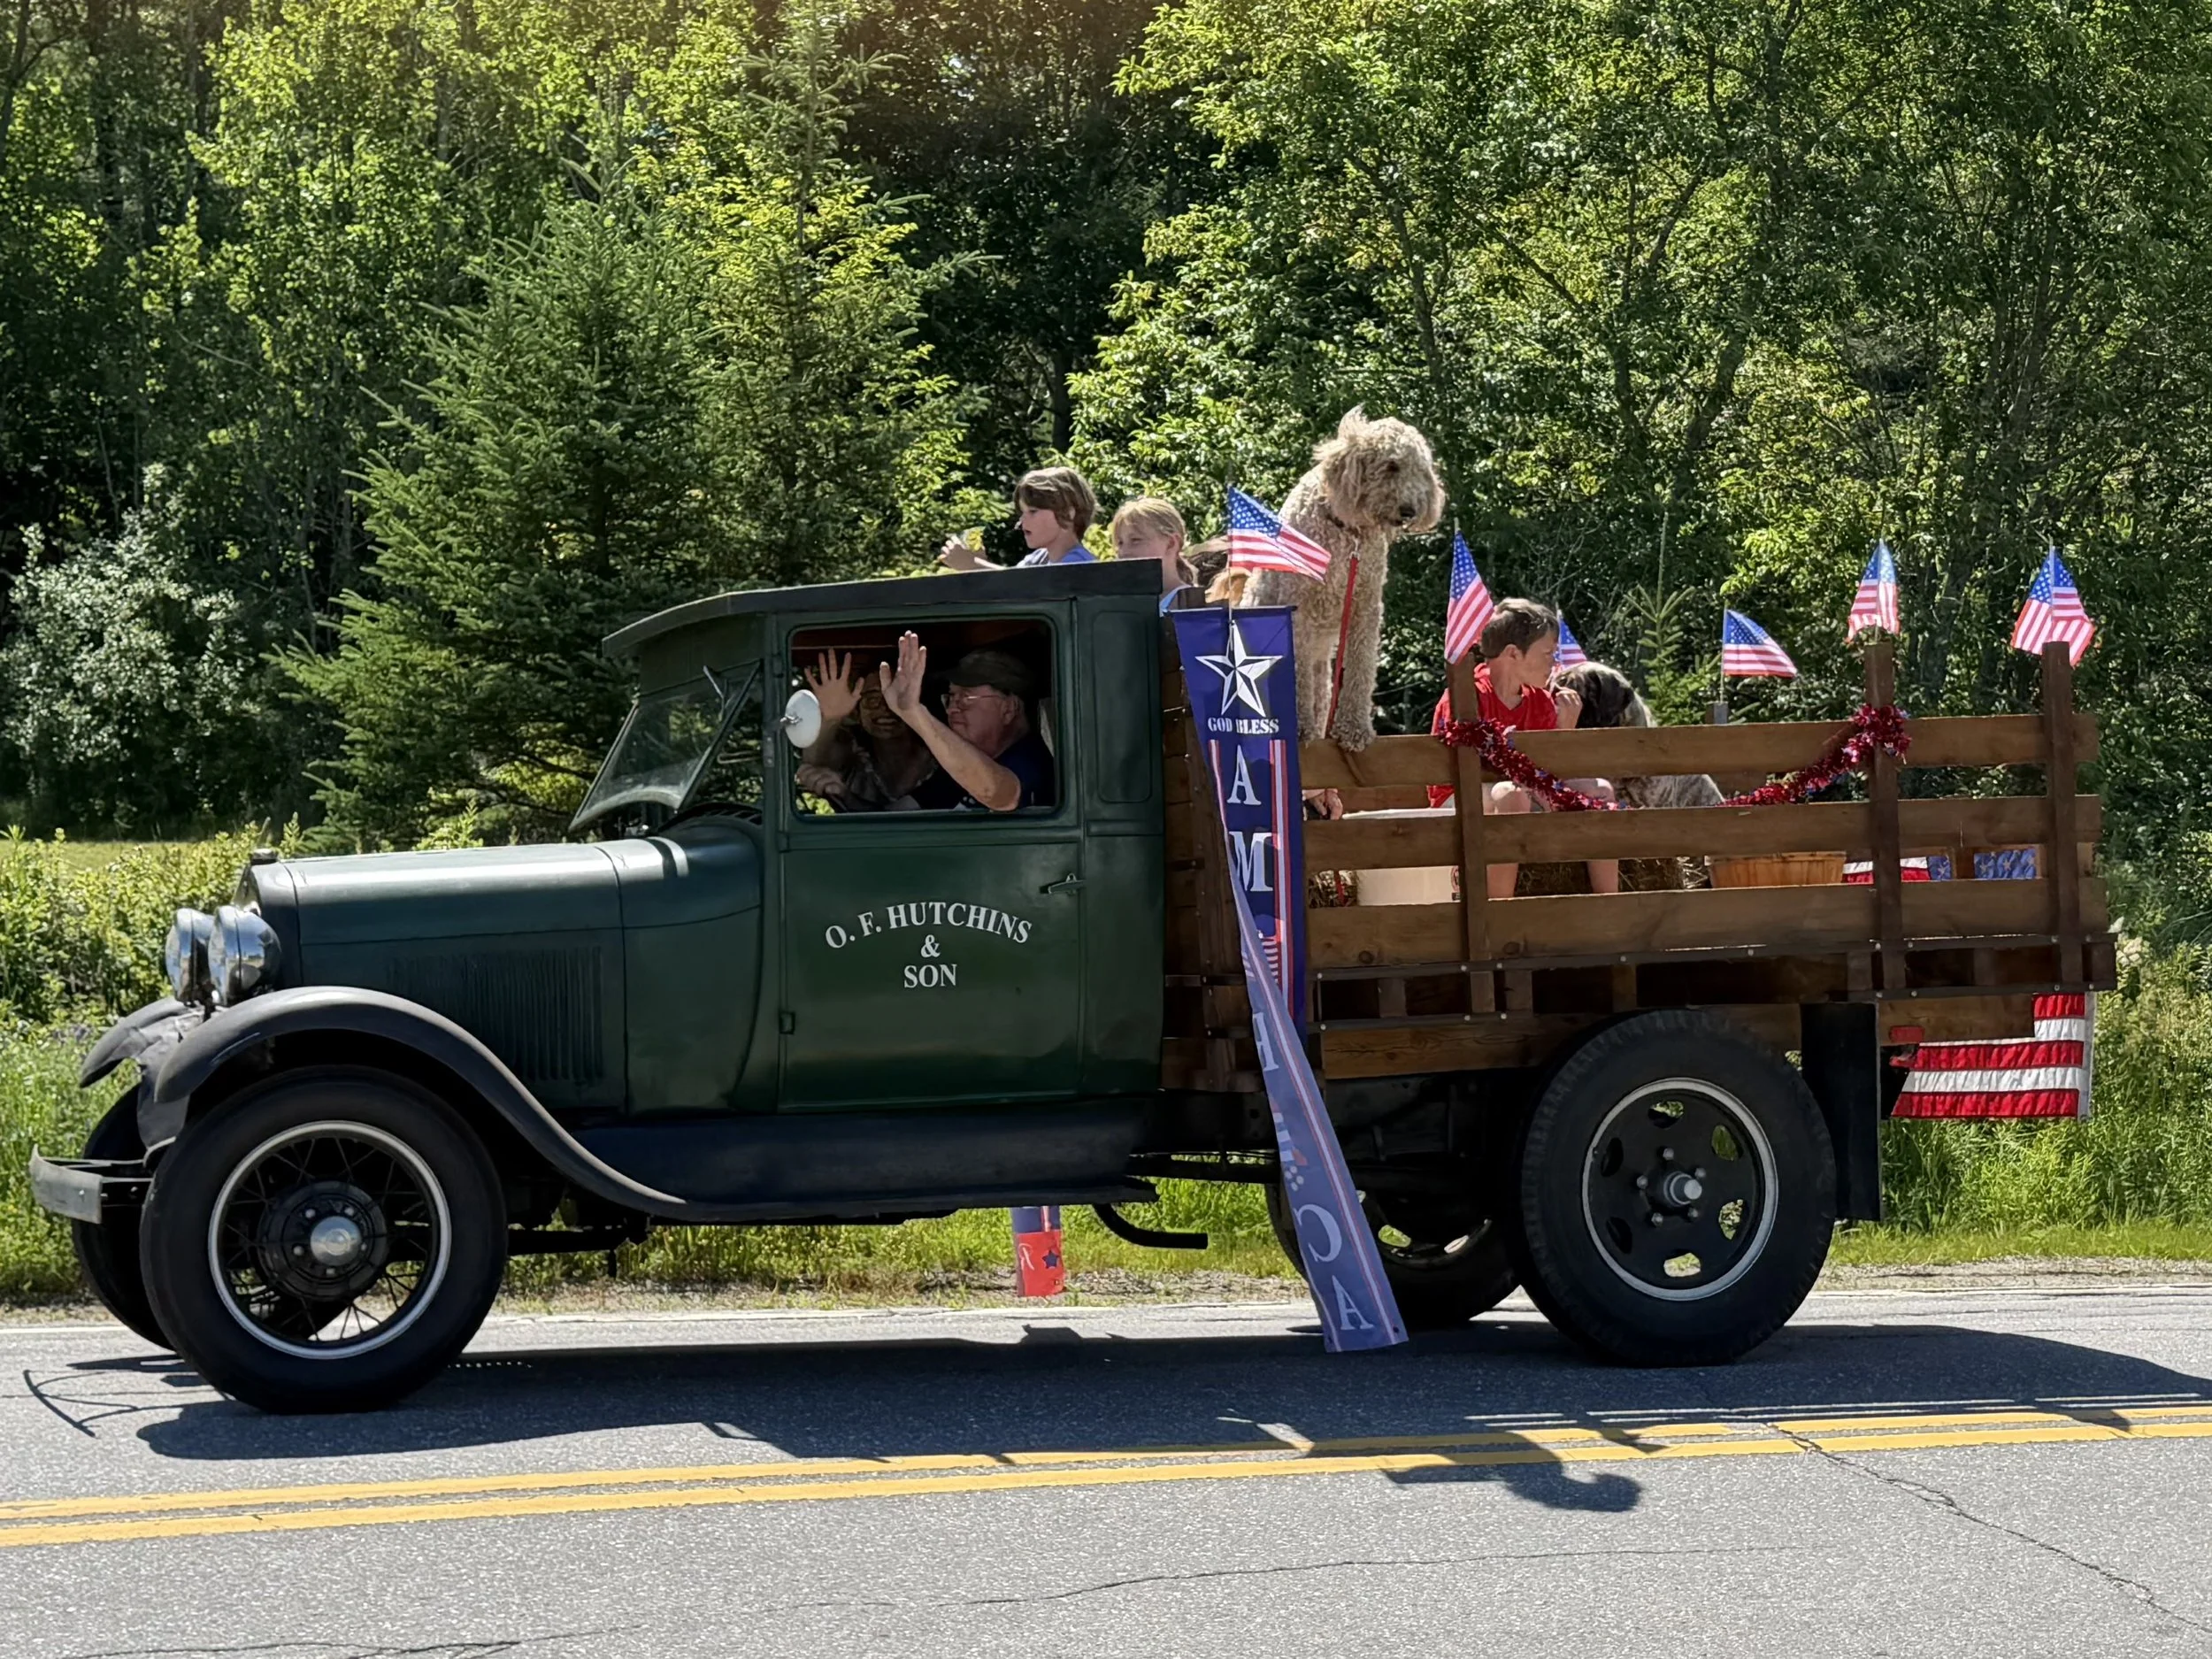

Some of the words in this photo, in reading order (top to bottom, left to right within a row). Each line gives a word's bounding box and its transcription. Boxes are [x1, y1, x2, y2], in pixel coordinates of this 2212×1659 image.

[1207, 717, 1233, 733] GOD
[1235, 718, 1279, 735] BLESS
[886, 901, 1033, 944] HUTCHINS
[920, 934, 941, 958] &
[903, 964, 957, 988] SON
